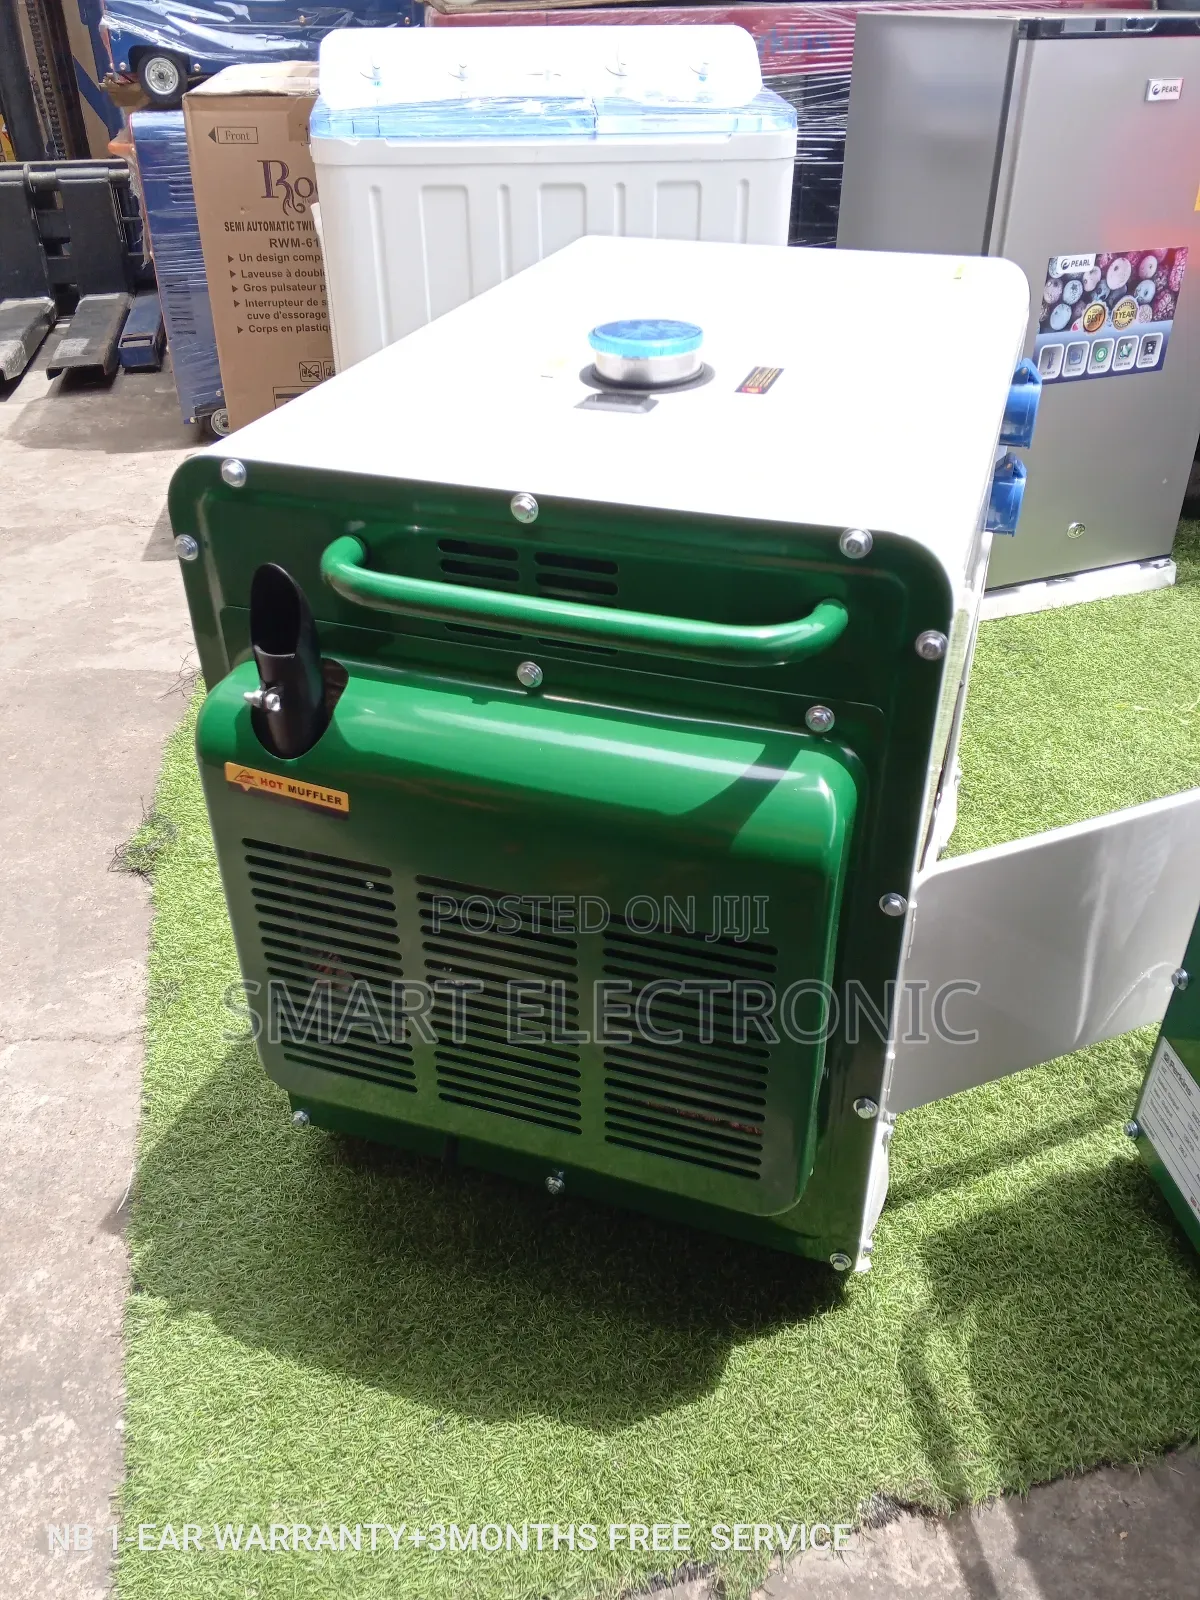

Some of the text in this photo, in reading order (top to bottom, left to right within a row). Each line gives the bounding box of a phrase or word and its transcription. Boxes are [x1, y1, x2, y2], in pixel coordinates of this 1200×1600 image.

[1161, 85, 1179, 93] PEARL
[225, 130, 250, 141] Front
[257, 159, 318, 216] Ro
[224, 221, 245, 232] SEMI
[247, 221, 295, 232] AUTOMATIC
[239, 253, 323, 264] Un design comp
[1070, 259, 1091, 268] PEARL
[241, 269, 283, 279] Laveuse
[286, 268, 292, 278] à
[243, 283, 267, 293] Gros
[271, 283, 316, 294] pulsateur
[245, 298, 304, 309] Interrupteur
[307, 298, 318, 306] de
[247, 310, 327, 321] cuve d'essorage
[1119, 310, 1135, 319] YEAR
[248, 324, 278, 335] Corps
[296, 323, 331, 334] plastiq
[260, 777, 342, 806] HOT MUFFLER
